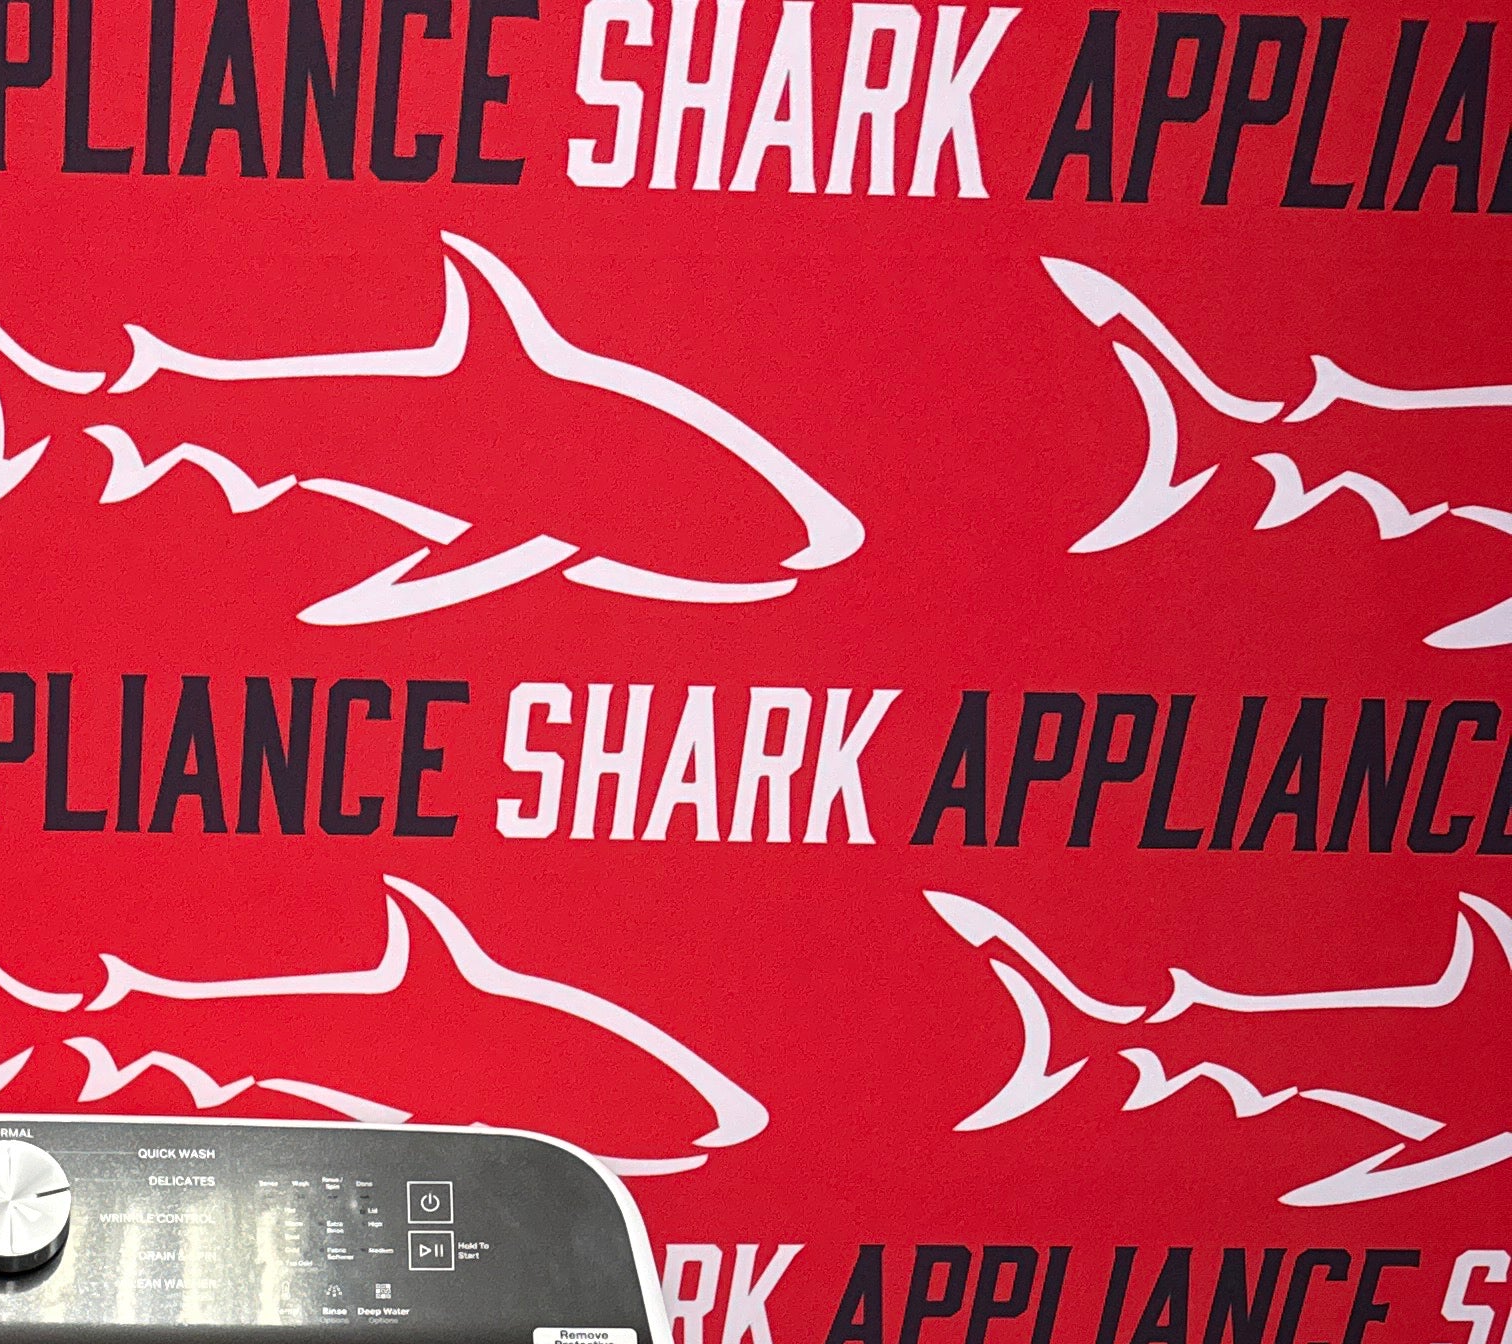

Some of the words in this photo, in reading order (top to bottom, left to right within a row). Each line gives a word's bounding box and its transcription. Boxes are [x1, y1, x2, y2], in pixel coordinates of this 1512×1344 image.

[566, 0, 1022, 199] SHARK
[1027, 9, 1512, 214] APPLIA
[496, 681, 904, 845] SHARK
[138, 1148, 177, 1159] QUICK
[179, 1149, 216, 1159] WASH
[148, 1176, 216, 1187] DELICATES
[99, 1213, 154, 1224] WRINKLE
[156, 1213, 216, 1224] CONTROL
[457, 1241, 478, 1250] Hold
[478, 1241, 490, 1250] To
[138, 1251, 176, 1261] DRAIN
[457, 1251, 480, 1260] Start
[322, 1307, 348, 1316] Rinse
[357, 1307, 381, 1317] Deep
[383, 1307, 411, 1316] Water
[559, 1329, 609, 1340] Remove
